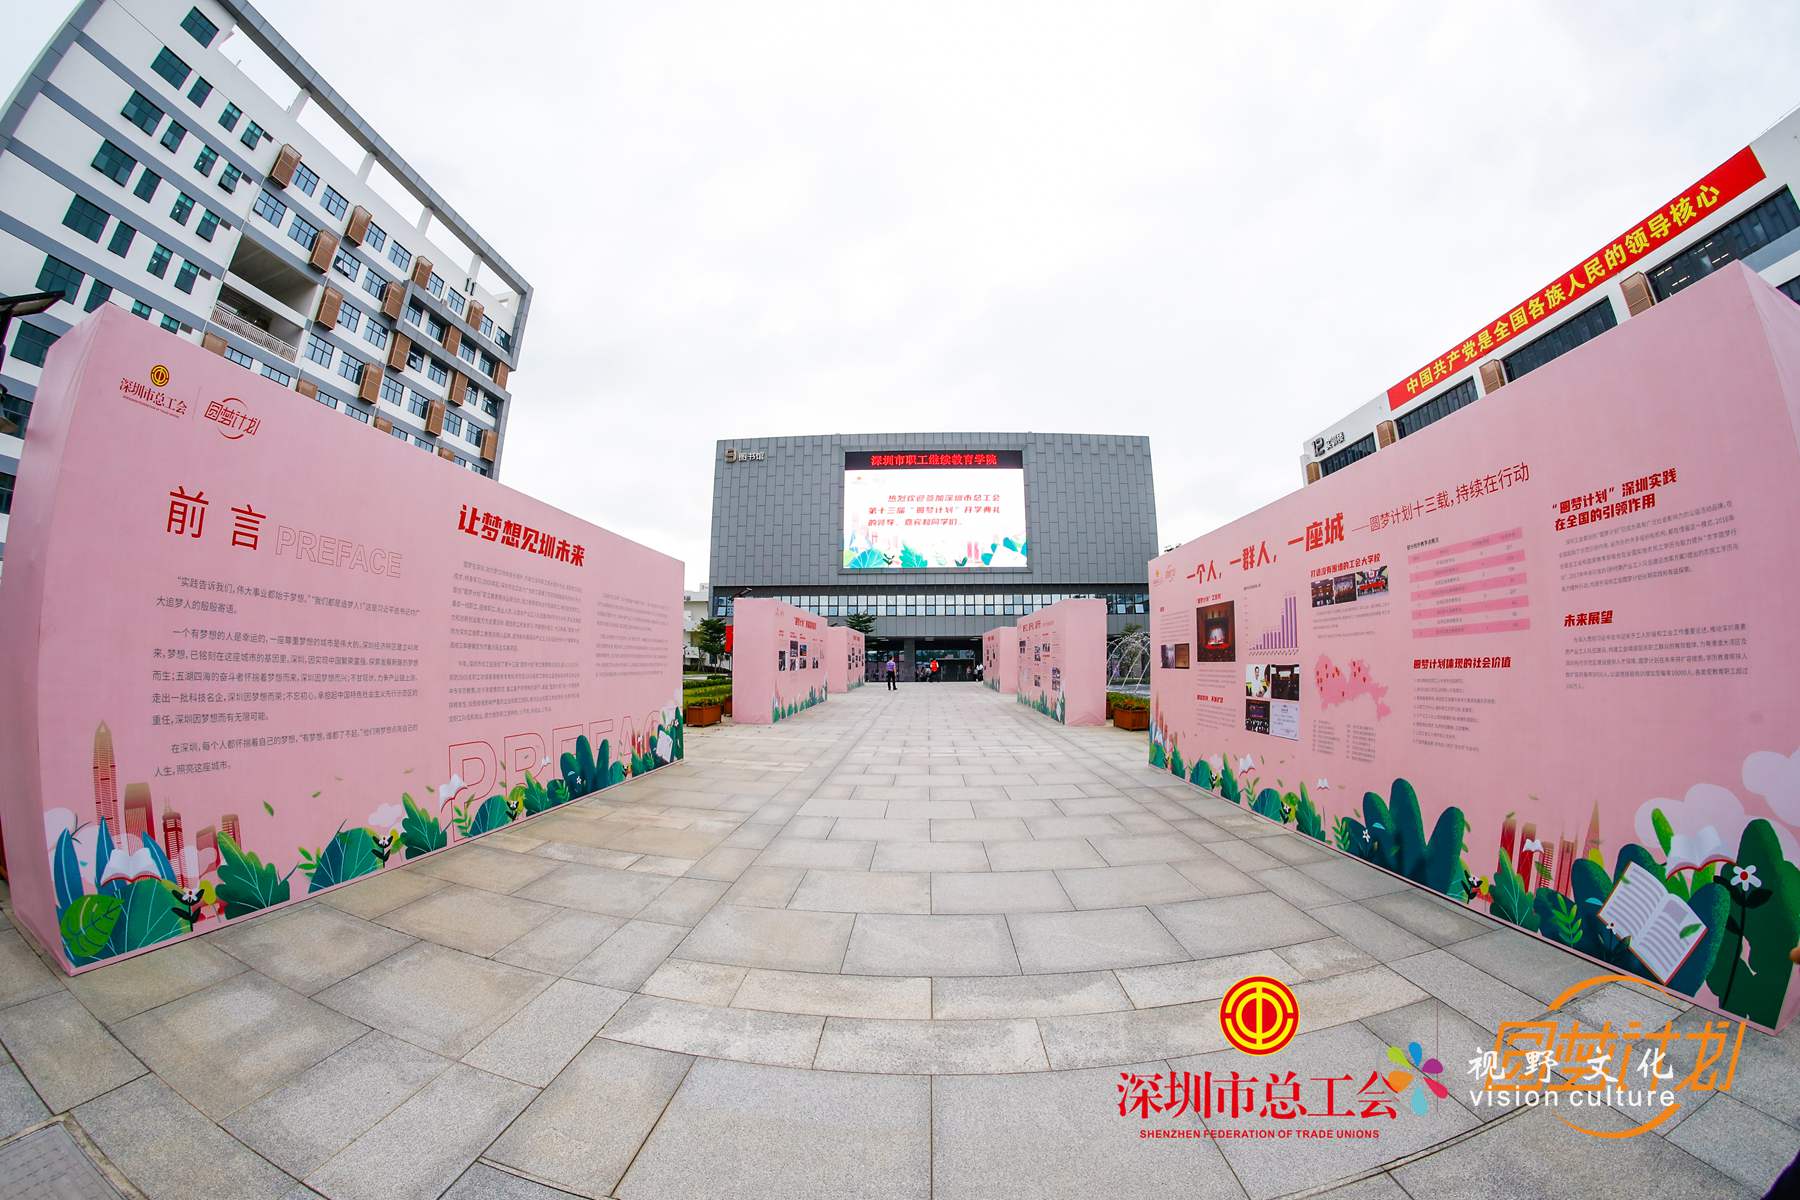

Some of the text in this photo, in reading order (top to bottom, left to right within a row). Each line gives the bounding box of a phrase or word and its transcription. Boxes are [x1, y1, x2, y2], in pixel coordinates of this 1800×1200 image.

[1406, 185, 1720, 395] 中国共产党是全国各族人民的领导核心
[120, 377, 188, 415] 深圳市总工会
[204, 400, 261, 436] 圆梦计划
[871, 454, 998, 467] 深圳市职工继续教育学院
[1555, 493, 1656, 531] 在全国的引领作用
[275, 525, 403, 578] PREFACE
[458, 504, 586, 567] 让梦想见圳未来
[1564, 610, 1614, 627] 未来展望
